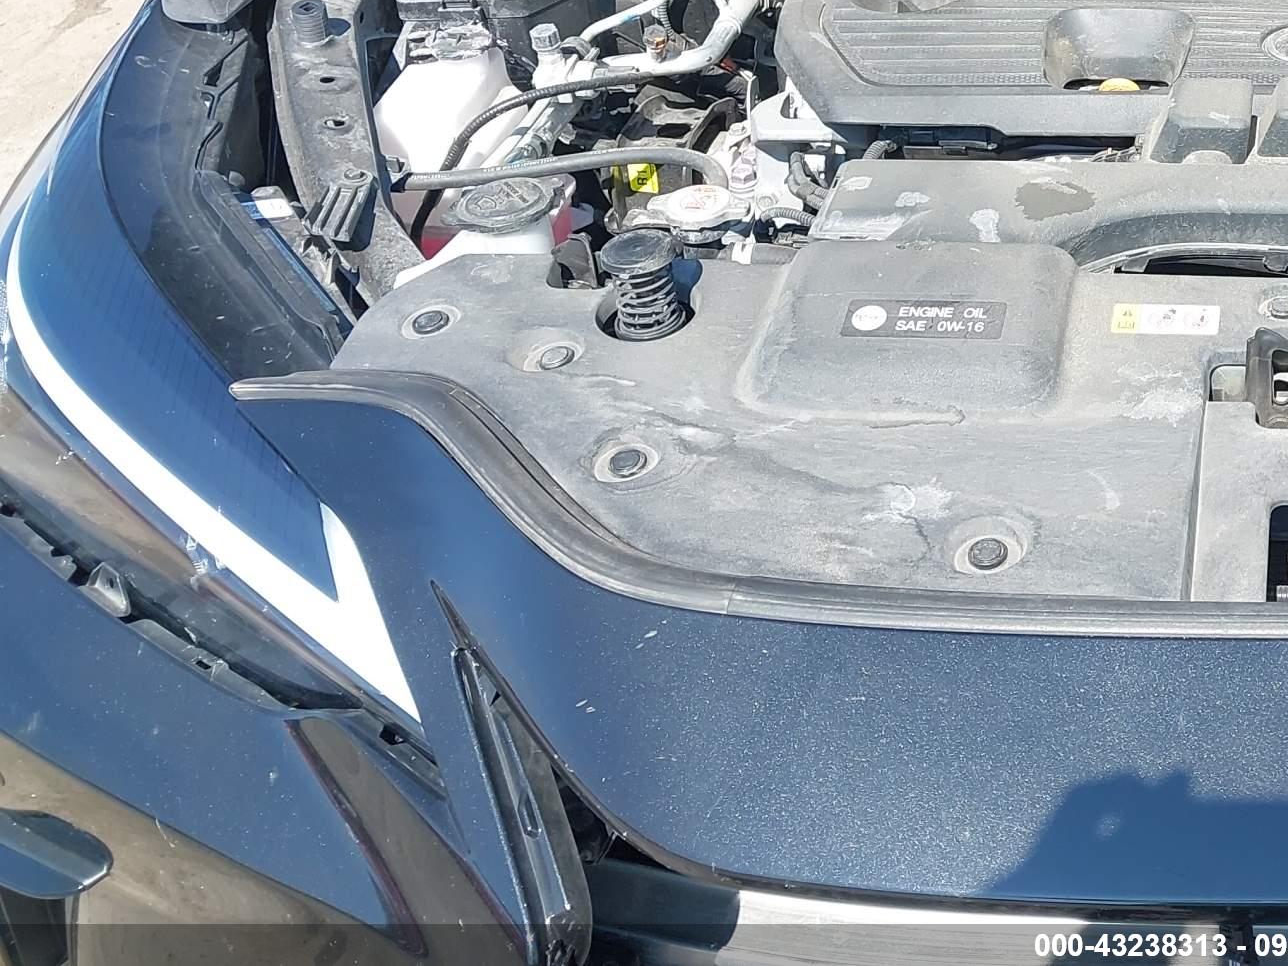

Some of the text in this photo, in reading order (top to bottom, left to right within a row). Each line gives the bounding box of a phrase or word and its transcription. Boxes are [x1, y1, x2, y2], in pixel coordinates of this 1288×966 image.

[898, 306, 987, 319] ENGINE OIL
[895, 320, 985, 332] SAE 0W-16
